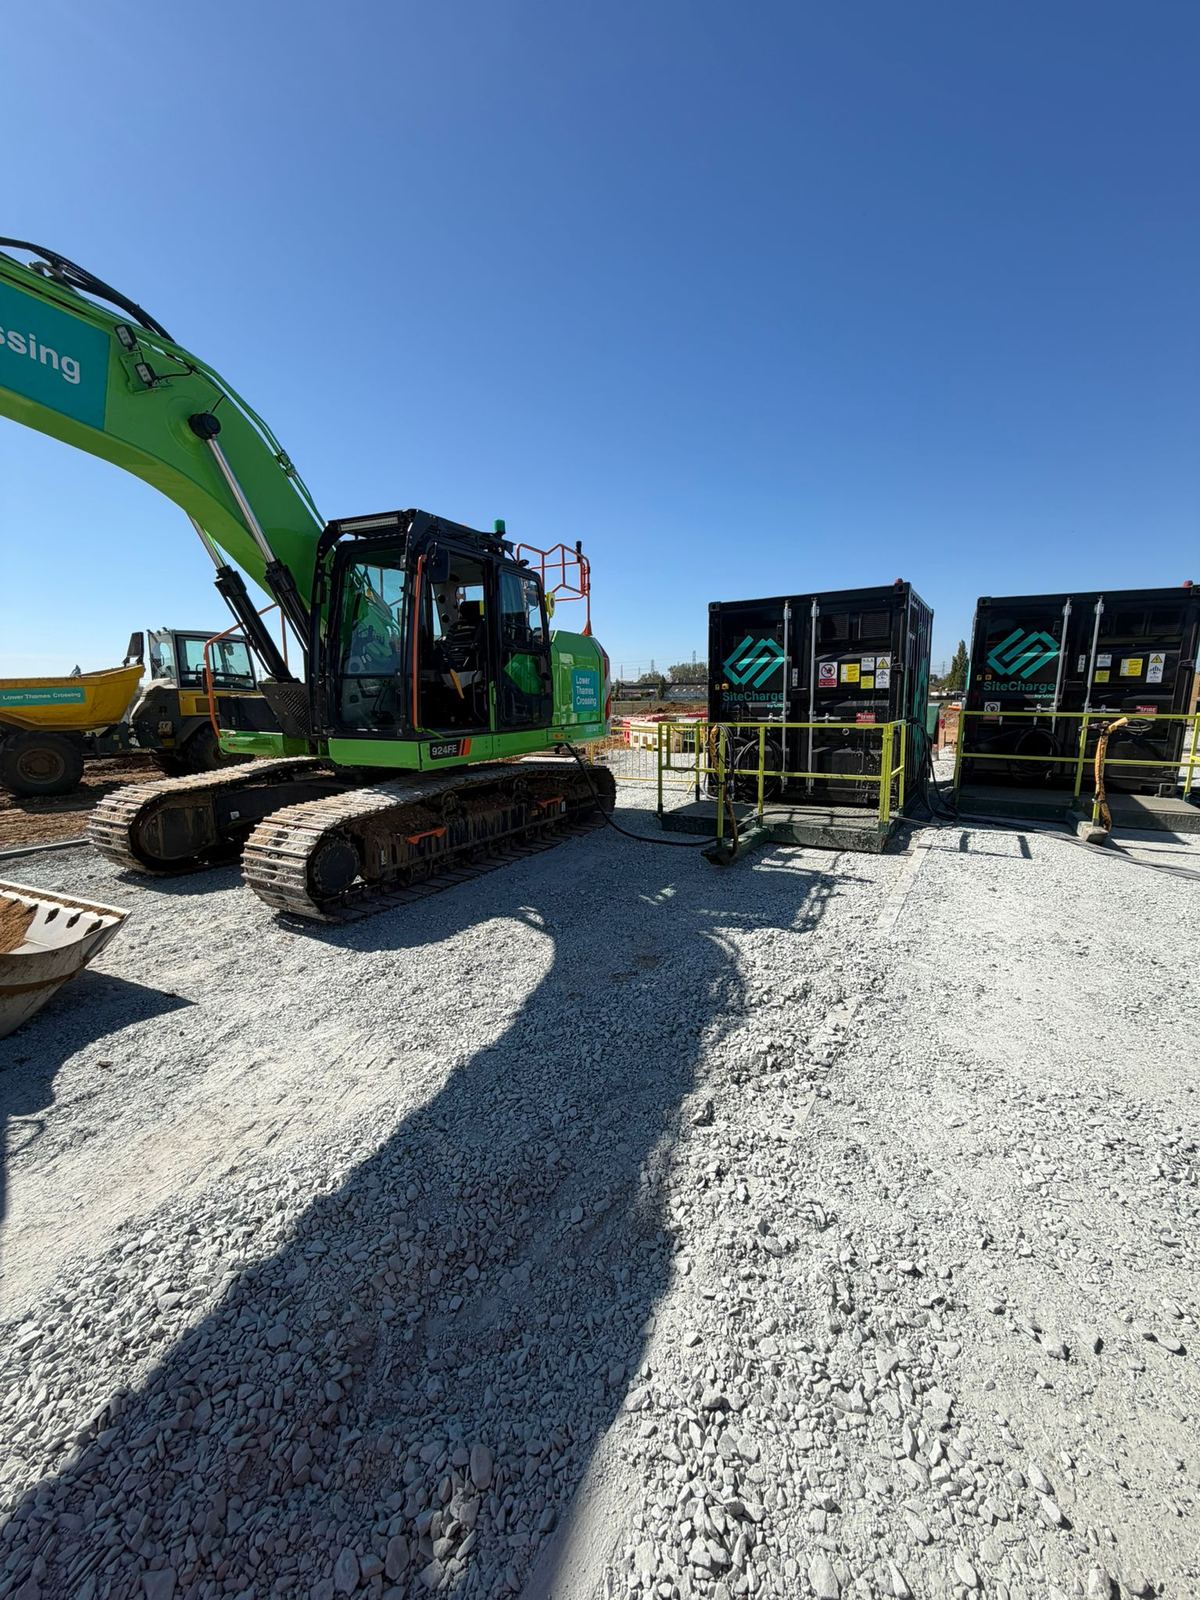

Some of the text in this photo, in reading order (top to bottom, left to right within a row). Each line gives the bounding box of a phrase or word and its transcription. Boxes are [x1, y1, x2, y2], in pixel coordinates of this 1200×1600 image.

[0, 326, 80, 384] sing
[575, 676, 590, 685] Lower
[983, 680, 1056, 693] SiteCharge
[575, 686, 593, 695] Thames
[576, 696, 596, 706] Crossing
[722, 691, 784, 703] SiteCharge
[431, 744, 458, 756] 924FE
